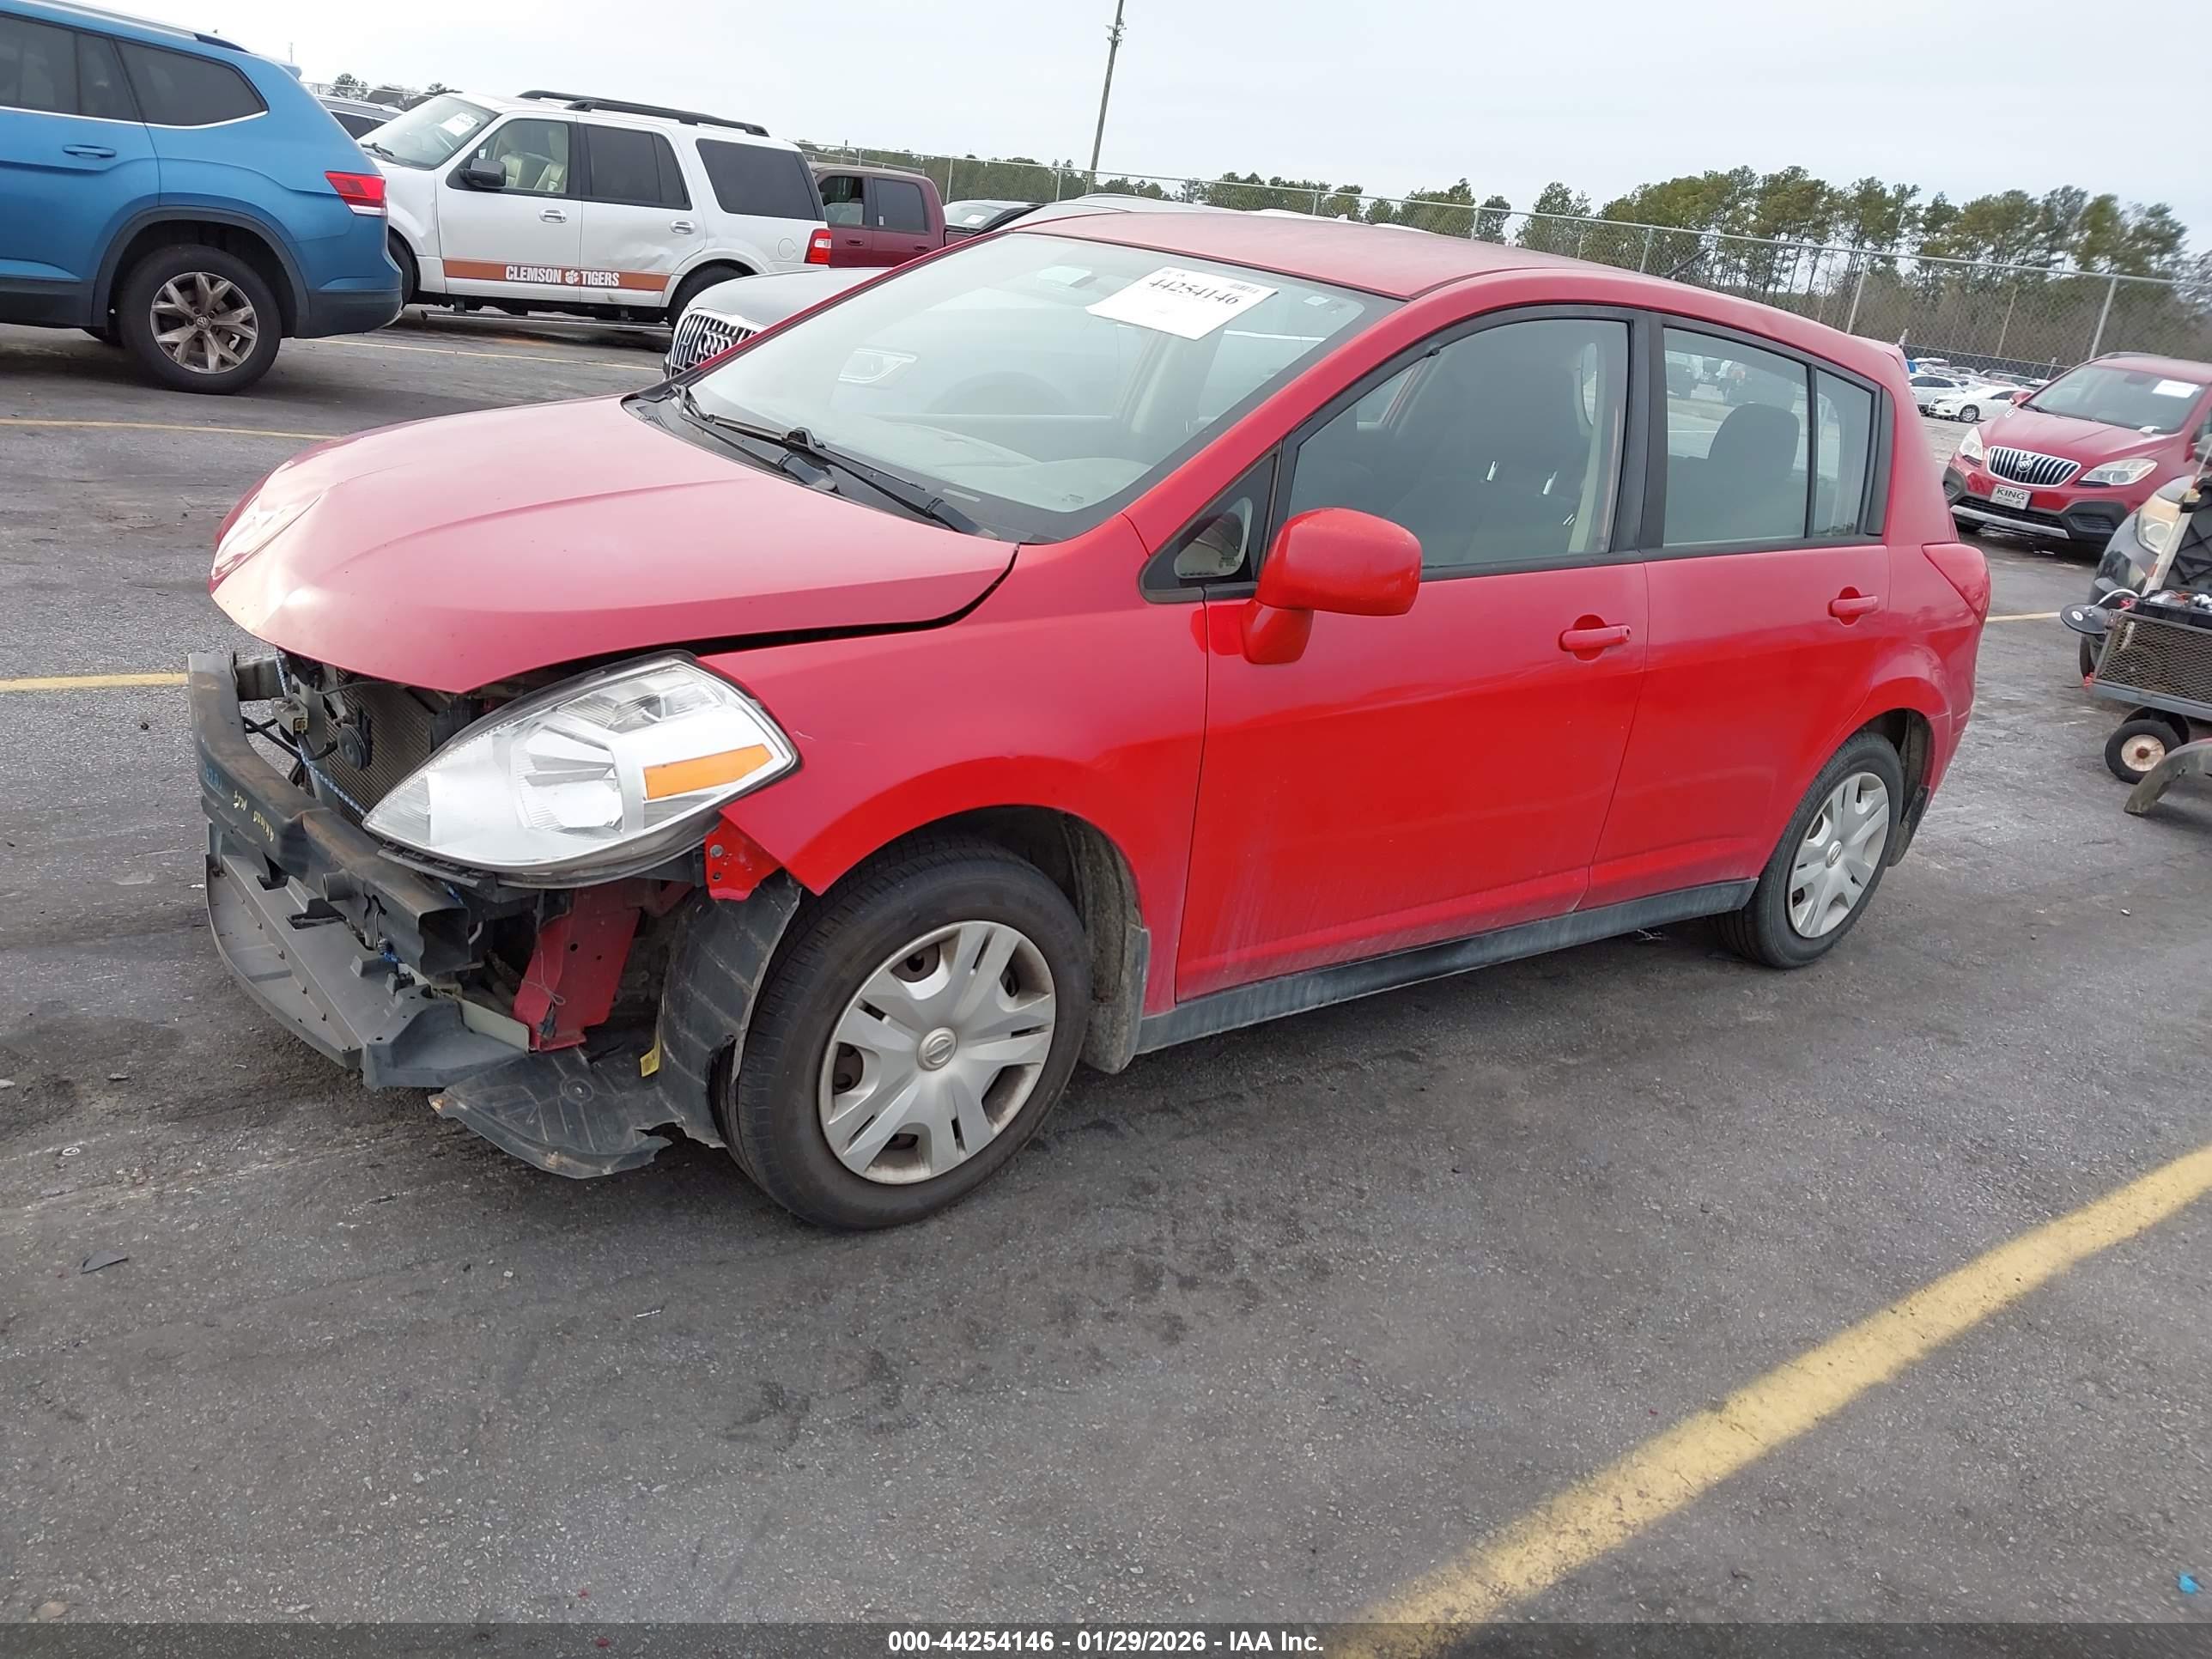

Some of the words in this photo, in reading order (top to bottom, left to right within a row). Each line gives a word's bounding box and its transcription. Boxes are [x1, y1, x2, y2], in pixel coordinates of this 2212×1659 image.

[505, 265, 562, 283] CLEMSON
[580, 270, 620, 287] TIGERS
[1149, 278, 1242, 305] 44254146
[1996, 488, 2025, 500] KING
